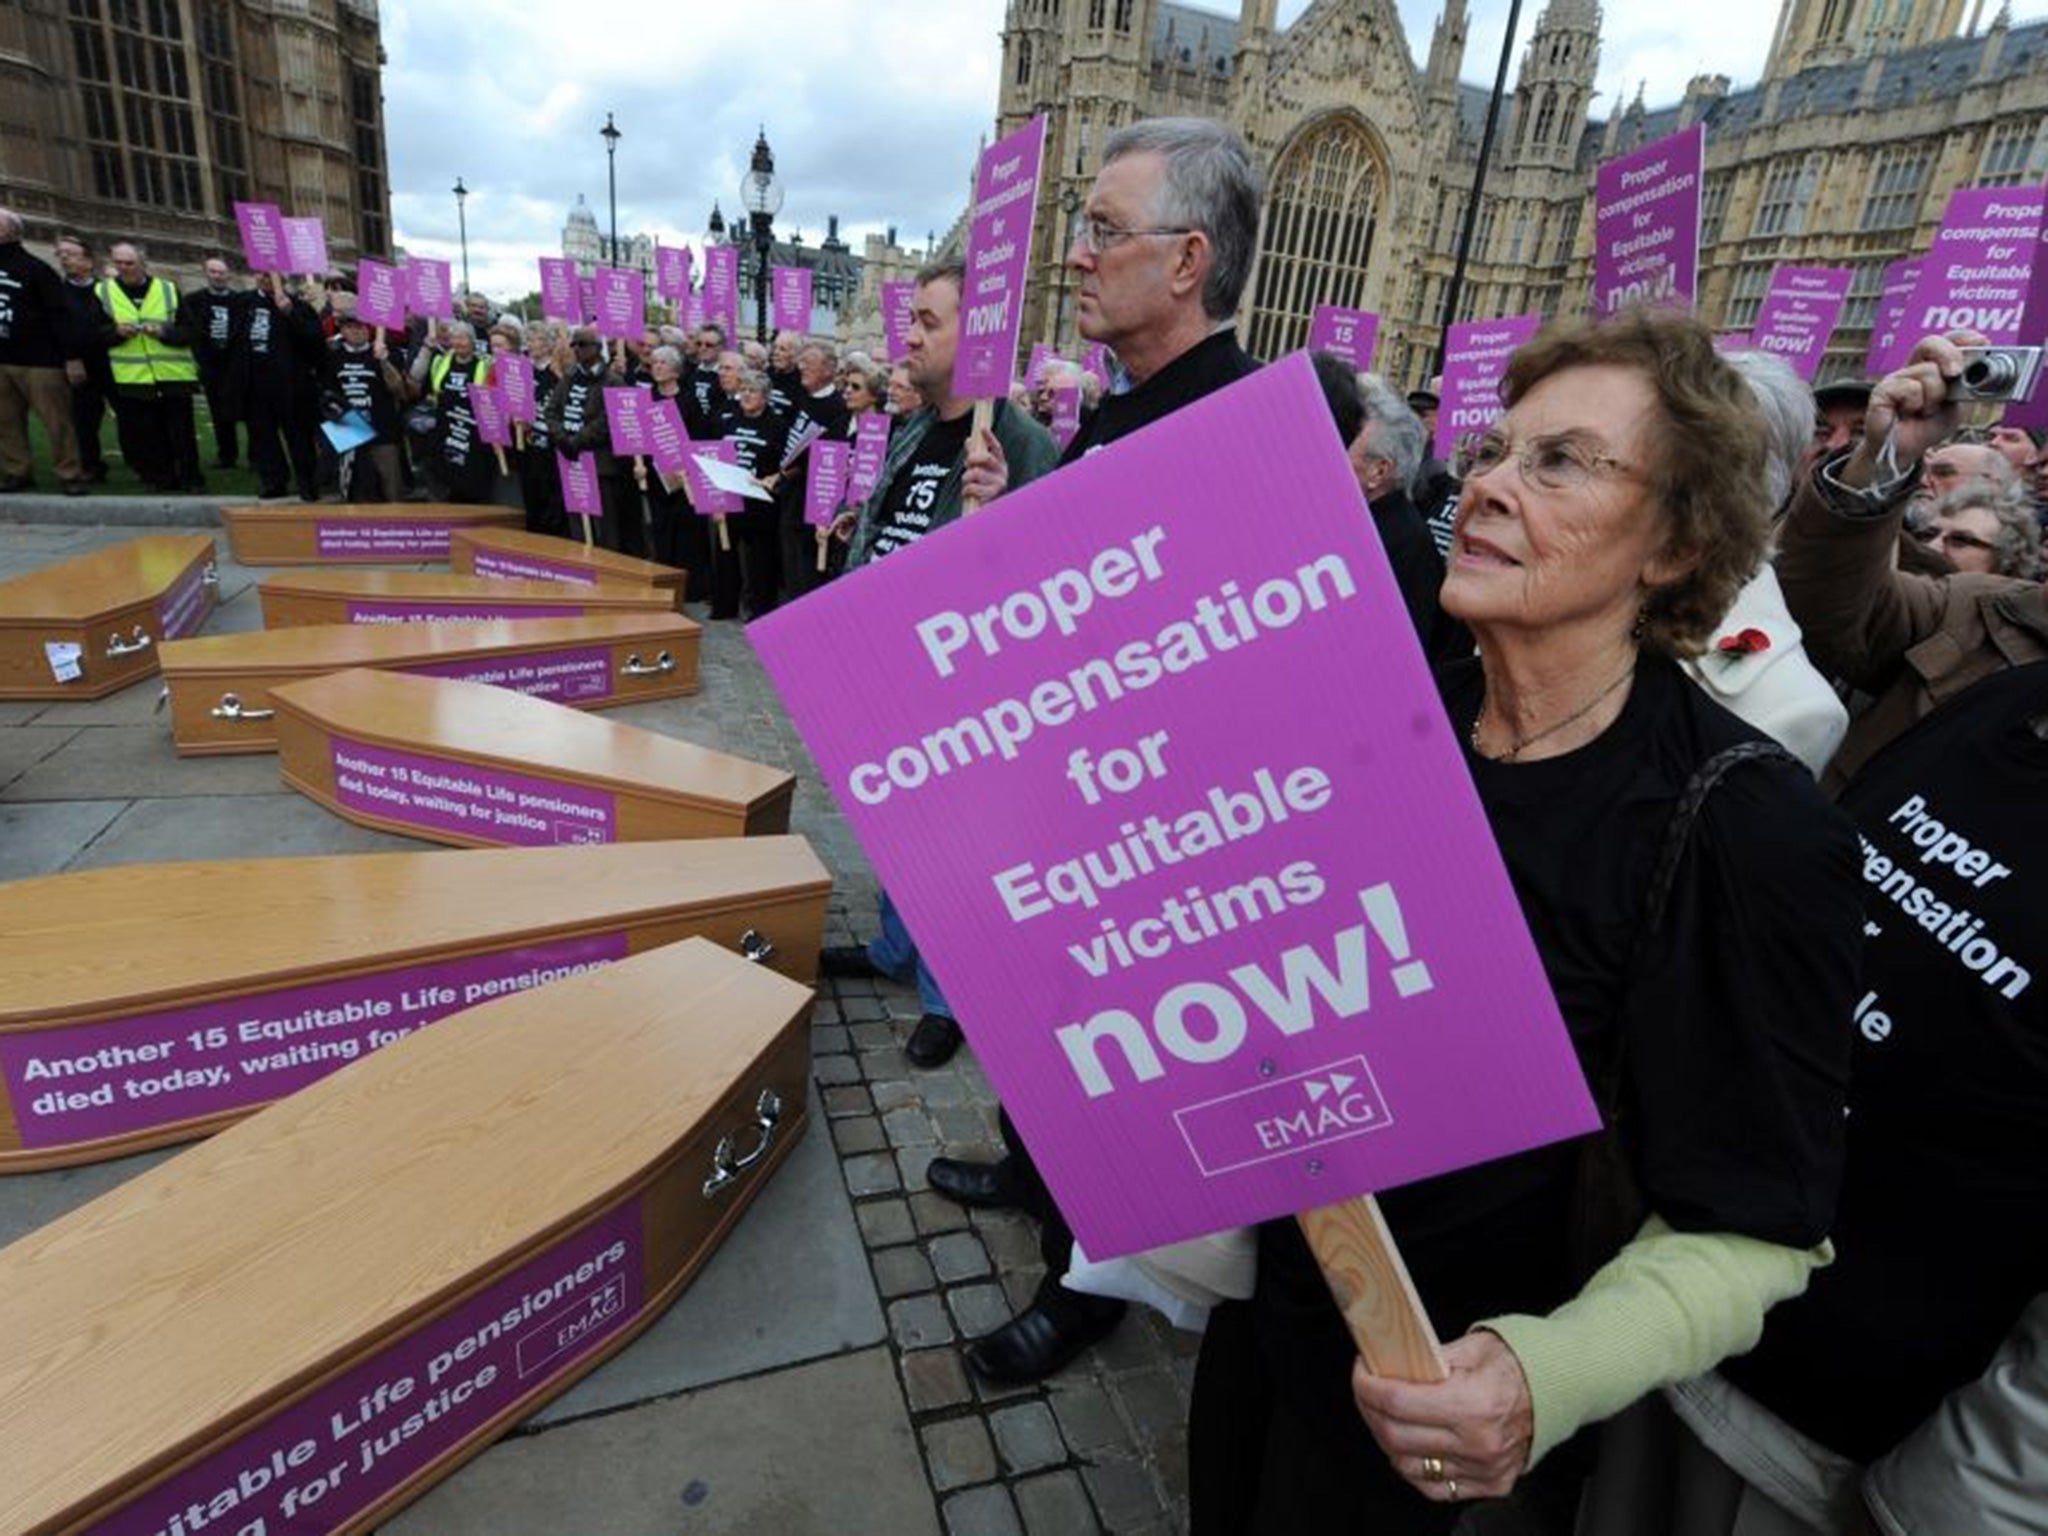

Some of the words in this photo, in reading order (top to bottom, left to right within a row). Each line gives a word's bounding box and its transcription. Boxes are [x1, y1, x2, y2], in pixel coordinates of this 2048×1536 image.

[1598, 174, 1694, 219] compensation
[1621, 158, 1667, 189] Proper
[1633, 211, 1653, 228] for
[1983, 203, 2043, 220] Prope
[1612, 226, 1675, 258] Equitable
[1618, 252, 1666, 276] victims
[1986, 244, 2016, 260] for
[966, 290, 1011, 335] now!
[1921, 301, 2025, 331] now!
[1949, 284, 2019, 300] victims
[1335, 326, 1353, 343] 15
[1761, 334, 1816, 354] now!
[906, 480, 938, 509] 15
[916, 525, 1167, 678] Proper
[509, 667, 534, 680] Life
[537, 660, 605, 679] pensioners
[848, 552, 1357, 806] compensation
[336, 752, 386, 777] Another
[391, 766, 407, 780] 15
[411, 769, 482, 797] Equitable
[486, 784, 516, 802] Life
[518, 793, 606, 821] pensioners
[1066, 729, 1170, 805] for
[366, 783, 410, 805] today,
[412, 793, 467, 817] waiting
[470, 803, 490, 820] for
[494, 809, 547, 831] justice
[991, 766, 1331, 923] Equitable
[1888, 794, 2012, 888] Proper
[1068, 859, 1326, 978] victims
[1054, 881, 1435, 1098] now!
[23, 1040, 174, 1081] Another
[187, 1027, 228, 1052] 15
[238, 997, 393, 1046] Equitable
[401, 985, 457, 1012] Life
[32, 1084, 114, 1116] died
[124, 1063, 231, 1097] today,
[240, 1035, 360, 1075] waiting
[1255, 1094, 1374, 1152] EMAG
[330, 1376, 415, 1442] Life
[427, 1240, 627, 1384] pensioners
[557, 1295, 618, 1347] EMAG
[279, 1463, 352, 1519] for
[360, 1361, 499, 1473] justice
